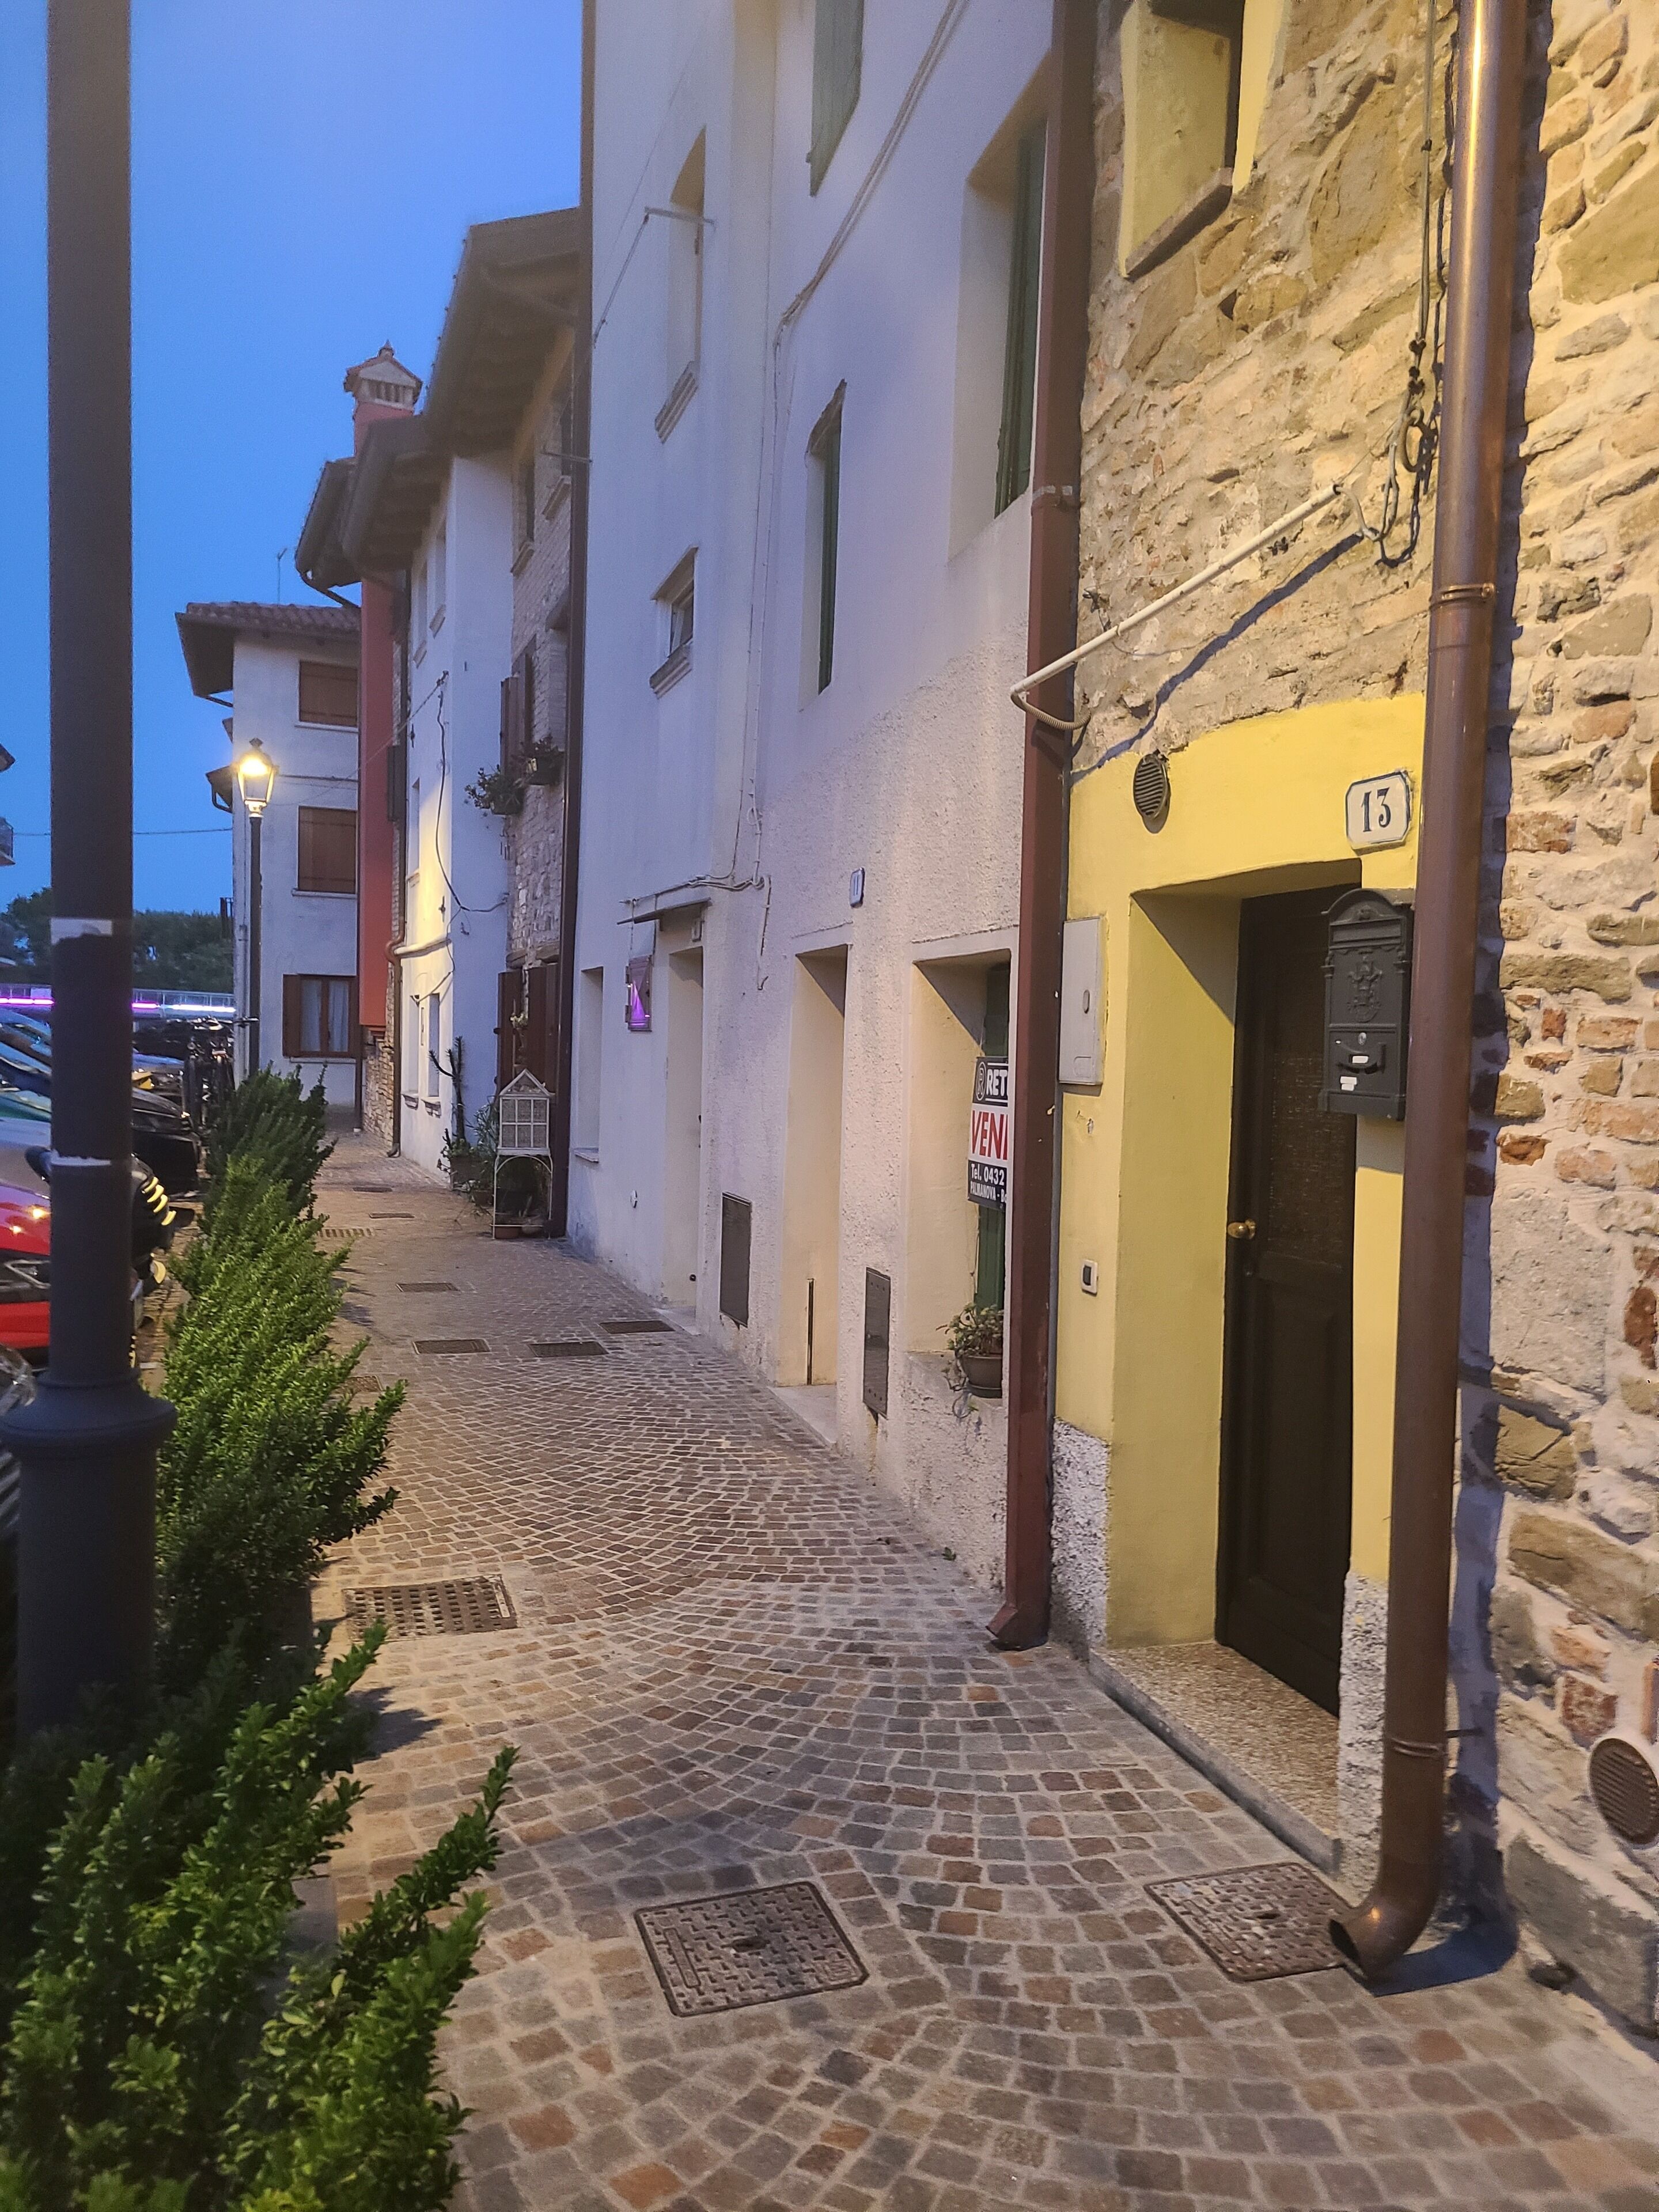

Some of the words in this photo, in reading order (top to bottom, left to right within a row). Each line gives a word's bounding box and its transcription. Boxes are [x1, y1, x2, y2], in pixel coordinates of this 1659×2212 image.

[1361, 787, 1391, 832] 13
[986, 1069, 1009, 1096] RET
[971, 1164, 982, 1181] Tel.
[984, 1166, 1005, 1185] 0432
